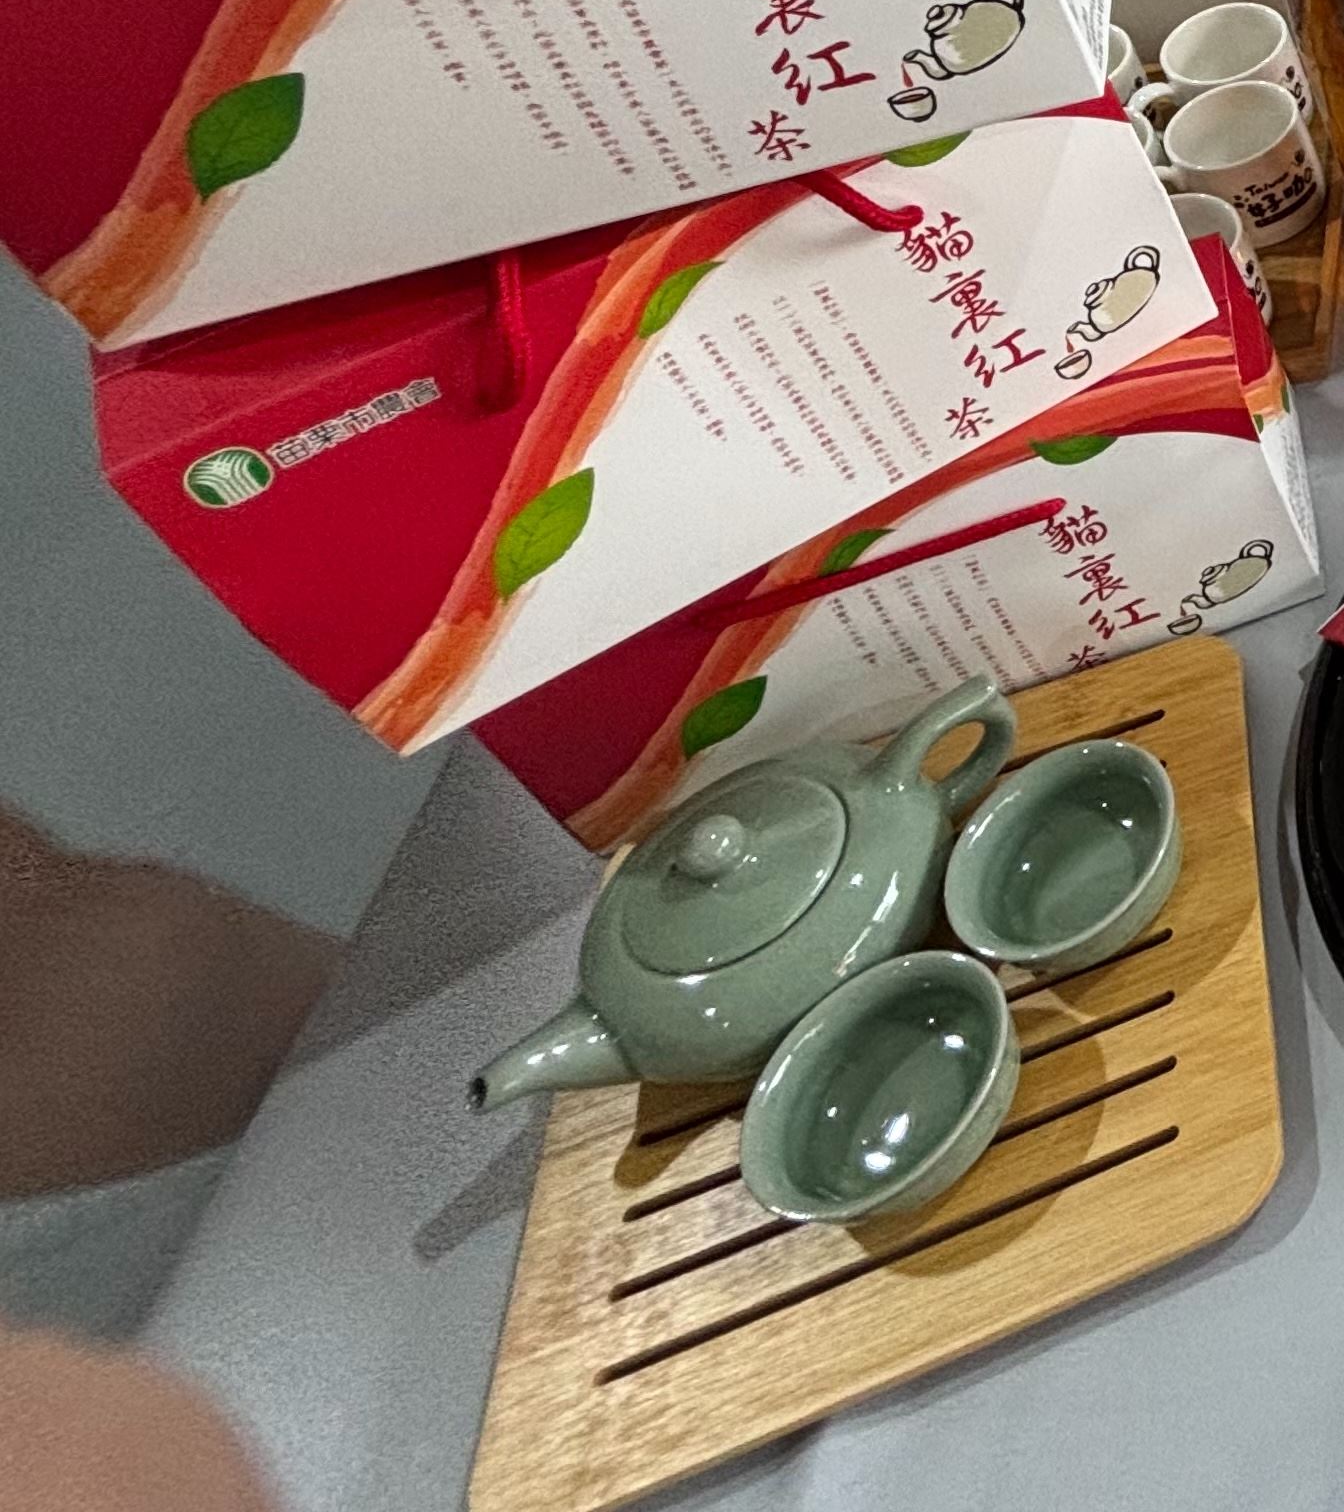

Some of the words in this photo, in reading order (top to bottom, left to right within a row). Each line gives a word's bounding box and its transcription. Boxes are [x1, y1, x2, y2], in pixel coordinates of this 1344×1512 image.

[266, 377, 442, 468] 苗栗市農會
